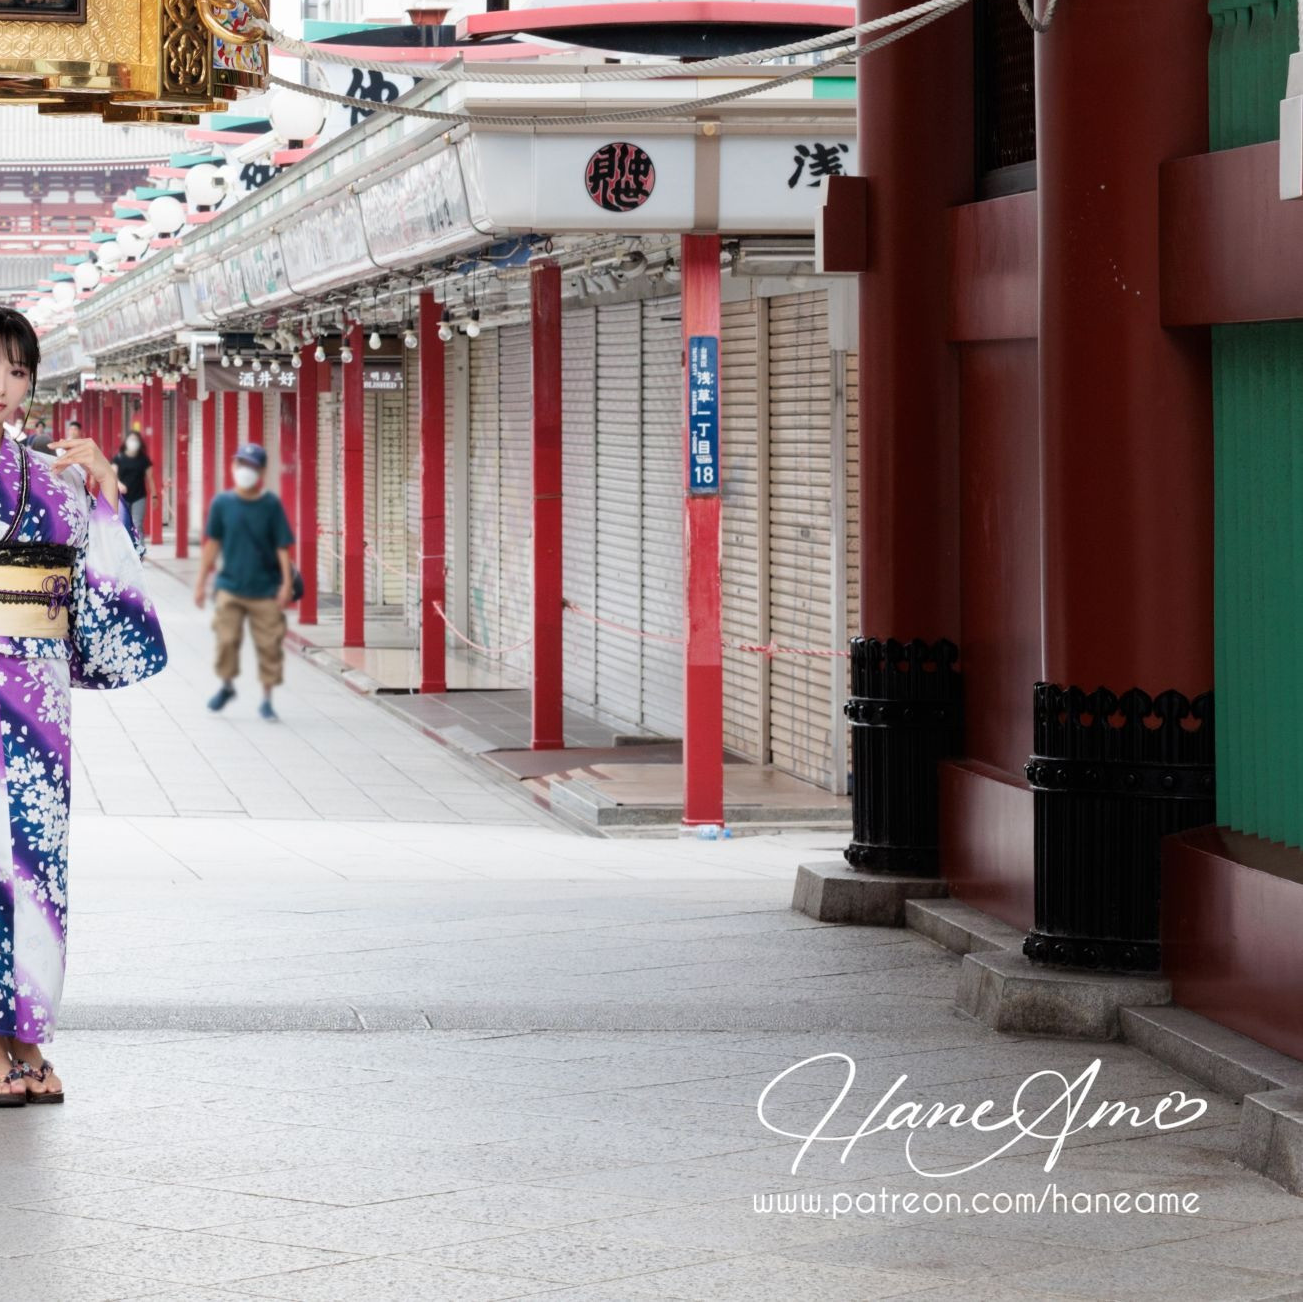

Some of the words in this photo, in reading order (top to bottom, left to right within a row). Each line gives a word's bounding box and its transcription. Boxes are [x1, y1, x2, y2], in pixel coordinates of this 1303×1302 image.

[697, 371, 711, 454] 浅草一丁目
[694, 466, 714, 483] 18
